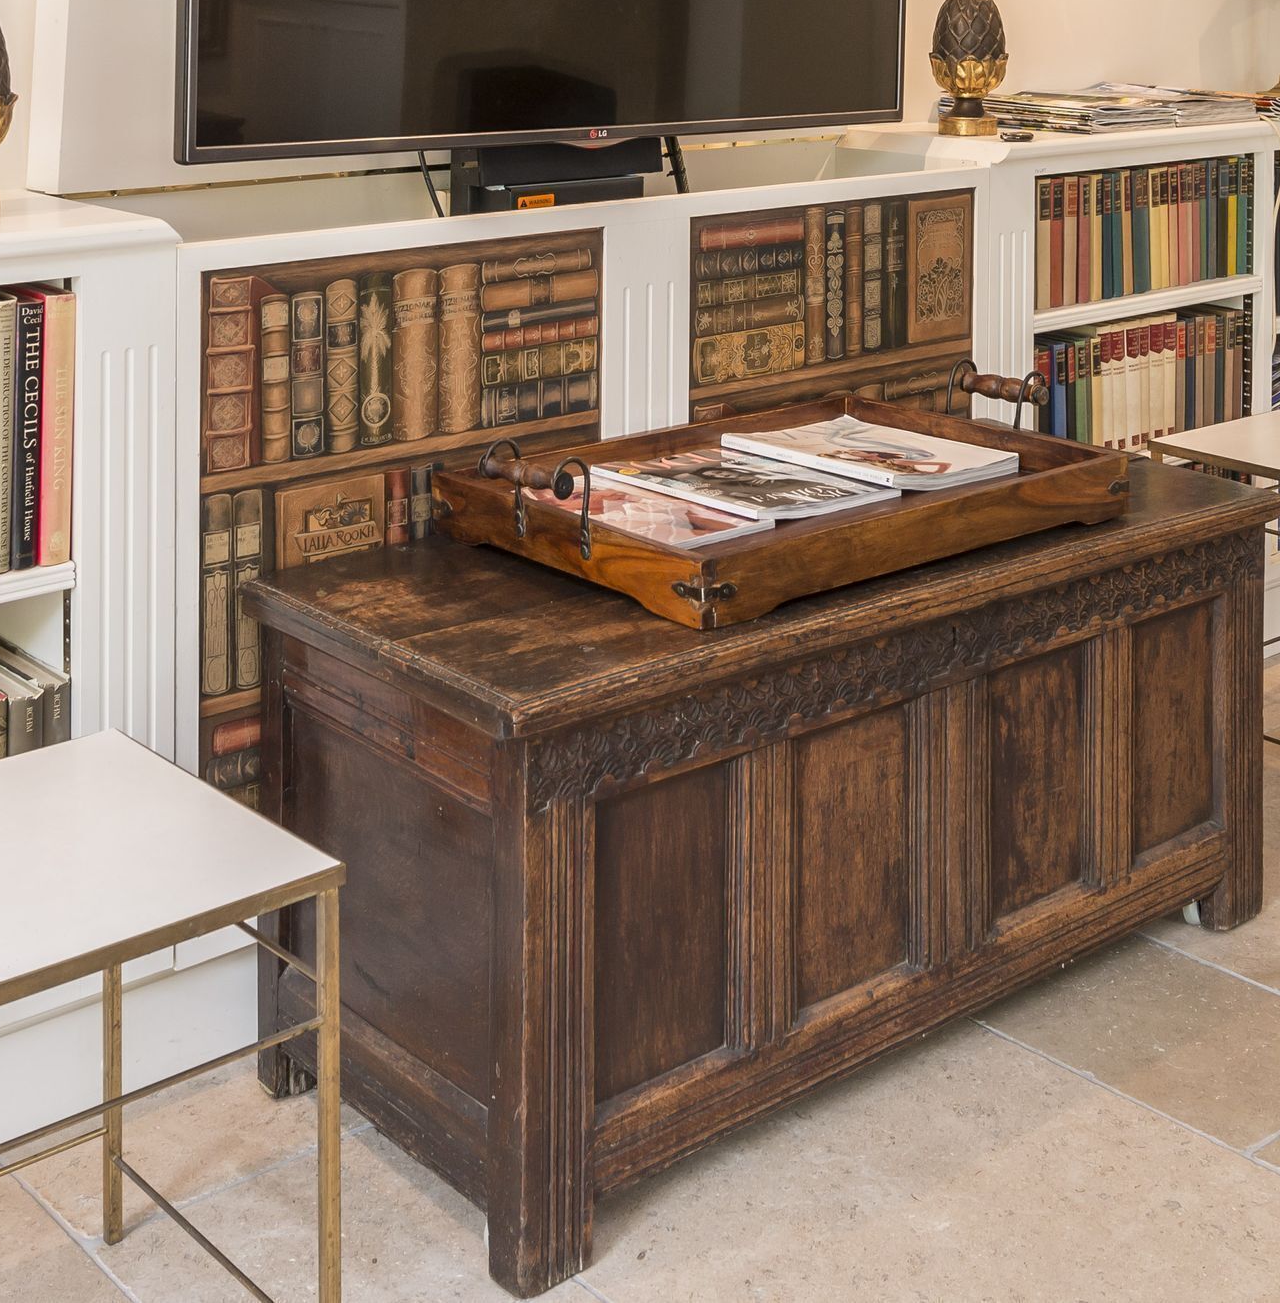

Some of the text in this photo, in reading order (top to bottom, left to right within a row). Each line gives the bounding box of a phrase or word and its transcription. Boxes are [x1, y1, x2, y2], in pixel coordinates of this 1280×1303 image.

[21, 307, 44, 316] David
[23, 327, 40, 541] THE CECILS of Hatfield House
[336, 525, 375, 547] ROOKH
[25, 707, 34, 733] RCHM
